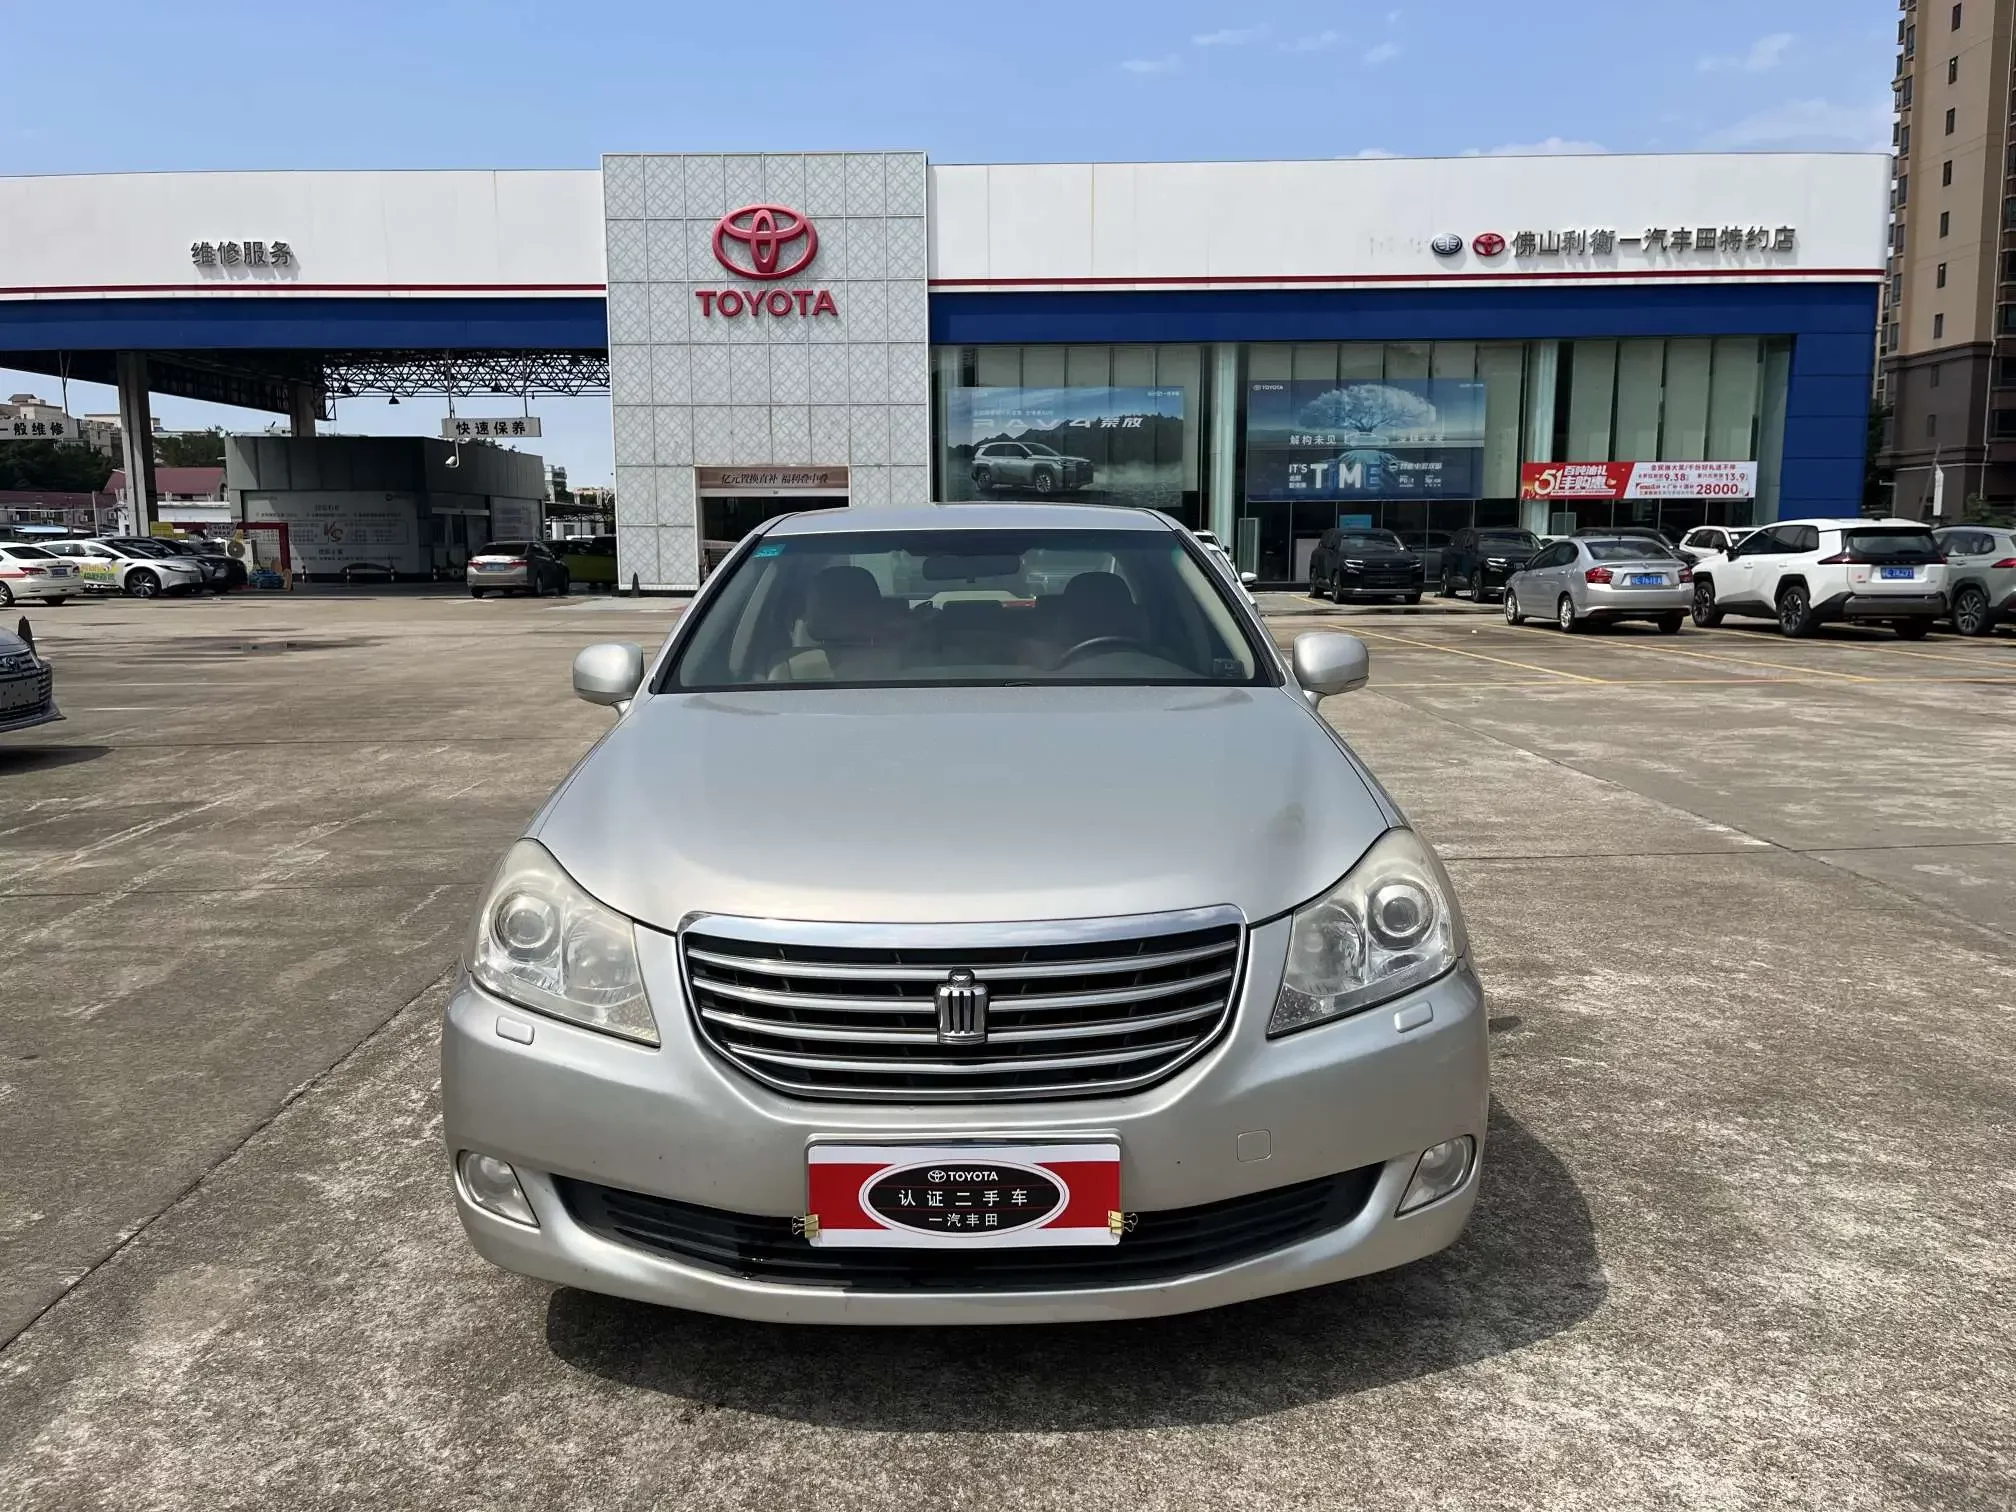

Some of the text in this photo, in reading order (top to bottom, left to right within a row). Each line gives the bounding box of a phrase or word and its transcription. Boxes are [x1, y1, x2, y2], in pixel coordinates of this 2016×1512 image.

[1512, 227, 1796, 258] 佛山利衡一汽丰田特约店
[191, 241, 293, 266] 维修服务
[695, 289, 838, 318] TOYOTA
[0, 422, 64, 436] 一般维修
[455, 421, 526, 435] 快速保养
[1696, 483, 1739, 495] 28000
[948, 1171, 999, 1182] TOYOTA
[898, 1189, 1029, 1207] 认证二手车
[928, 1213, 999, 1228] 一汽丰田
